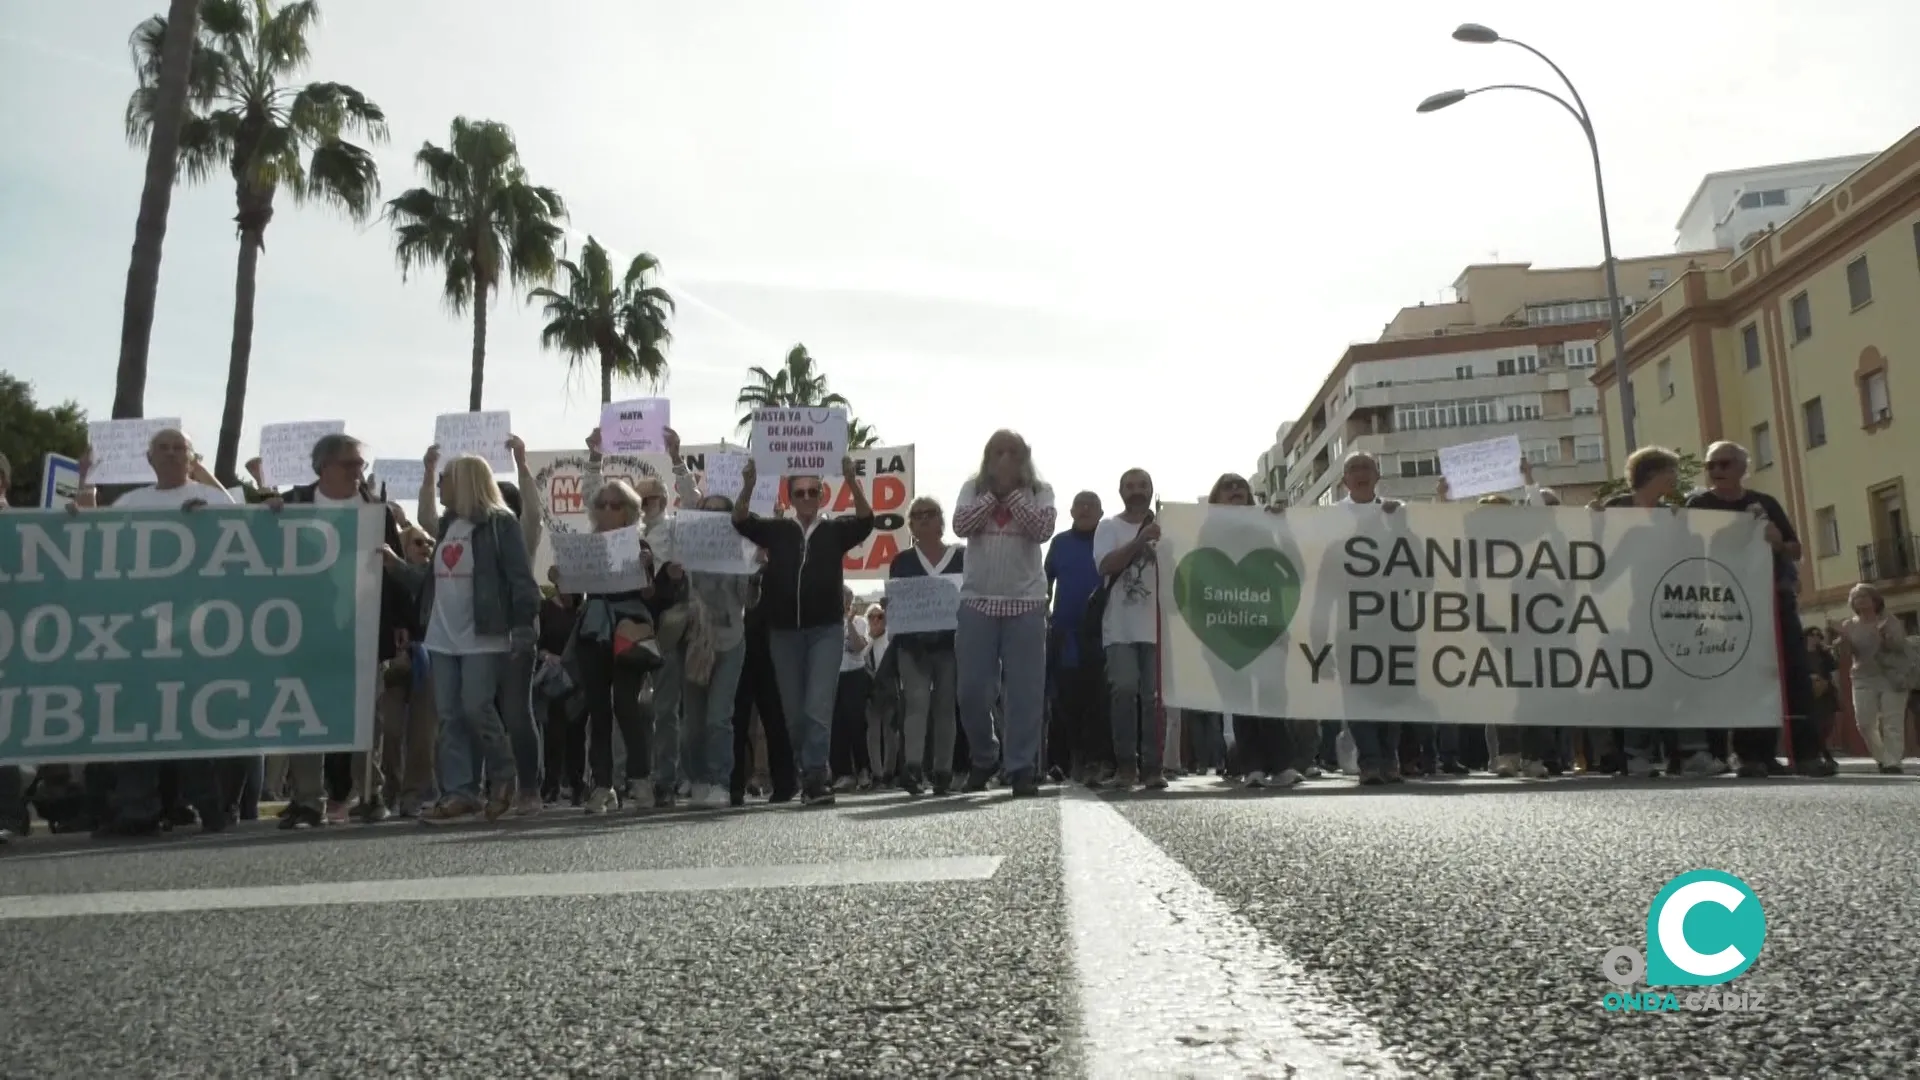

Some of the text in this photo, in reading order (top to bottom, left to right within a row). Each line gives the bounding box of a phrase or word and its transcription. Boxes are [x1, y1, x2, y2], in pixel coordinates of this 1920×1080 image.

[754, 411, 801, 422] BASTA YA
[768, 425, 814, 436] DE JUGAR
[769, 441, 833, 452] CON NUESTRA
[787, 456, 825, 468] SALUD
[876, 455, 905, 474] LA
[0, 518, 341, 583] NIDAD
[1343, 536, 1607, 581] SANIDAD
[1203, 586, 1271, 602] Sanidad
[1664, 583, 1736, 604] MAREA
[1206, 608, 1269, 627] pública
[1348, 589, 1609, 636] PÚBLICA
[1298, 643, 1654, 691] Y DE CALIDAD
